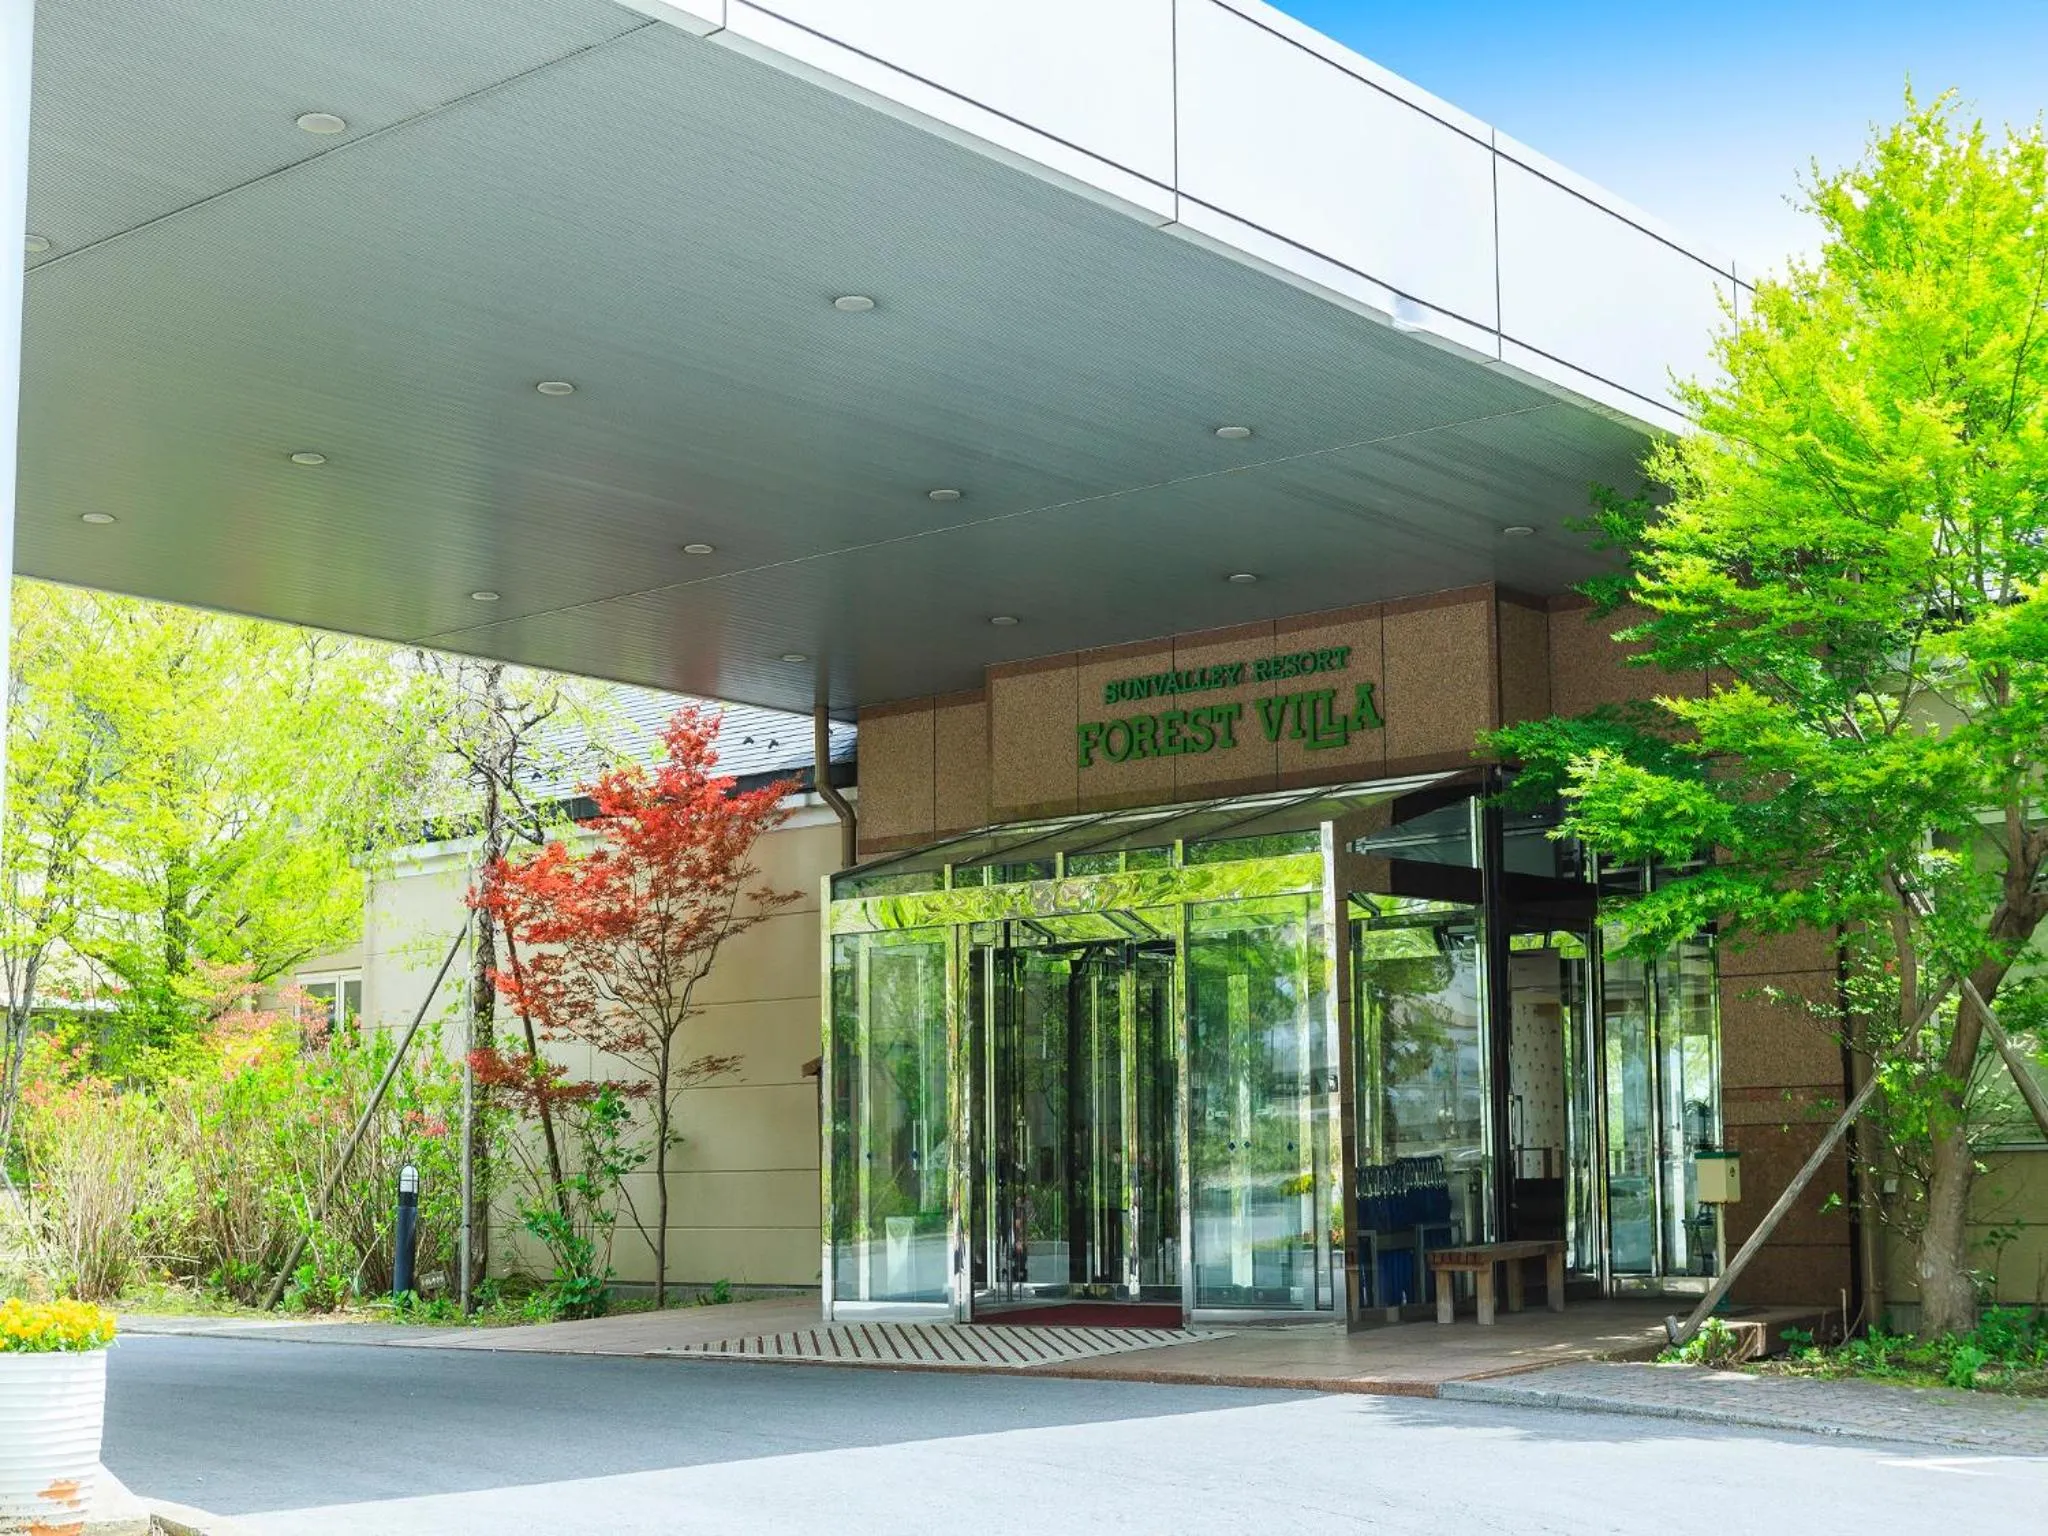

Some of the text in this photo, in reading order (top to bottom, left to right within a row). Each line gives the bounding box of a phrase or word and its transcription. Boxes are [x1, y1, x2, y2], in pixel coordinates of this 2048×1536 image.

[1105, 647, 1350, 703] SUNVALLEY RESORT
[1077, 683, 1384, 767] FOREST VILLA
